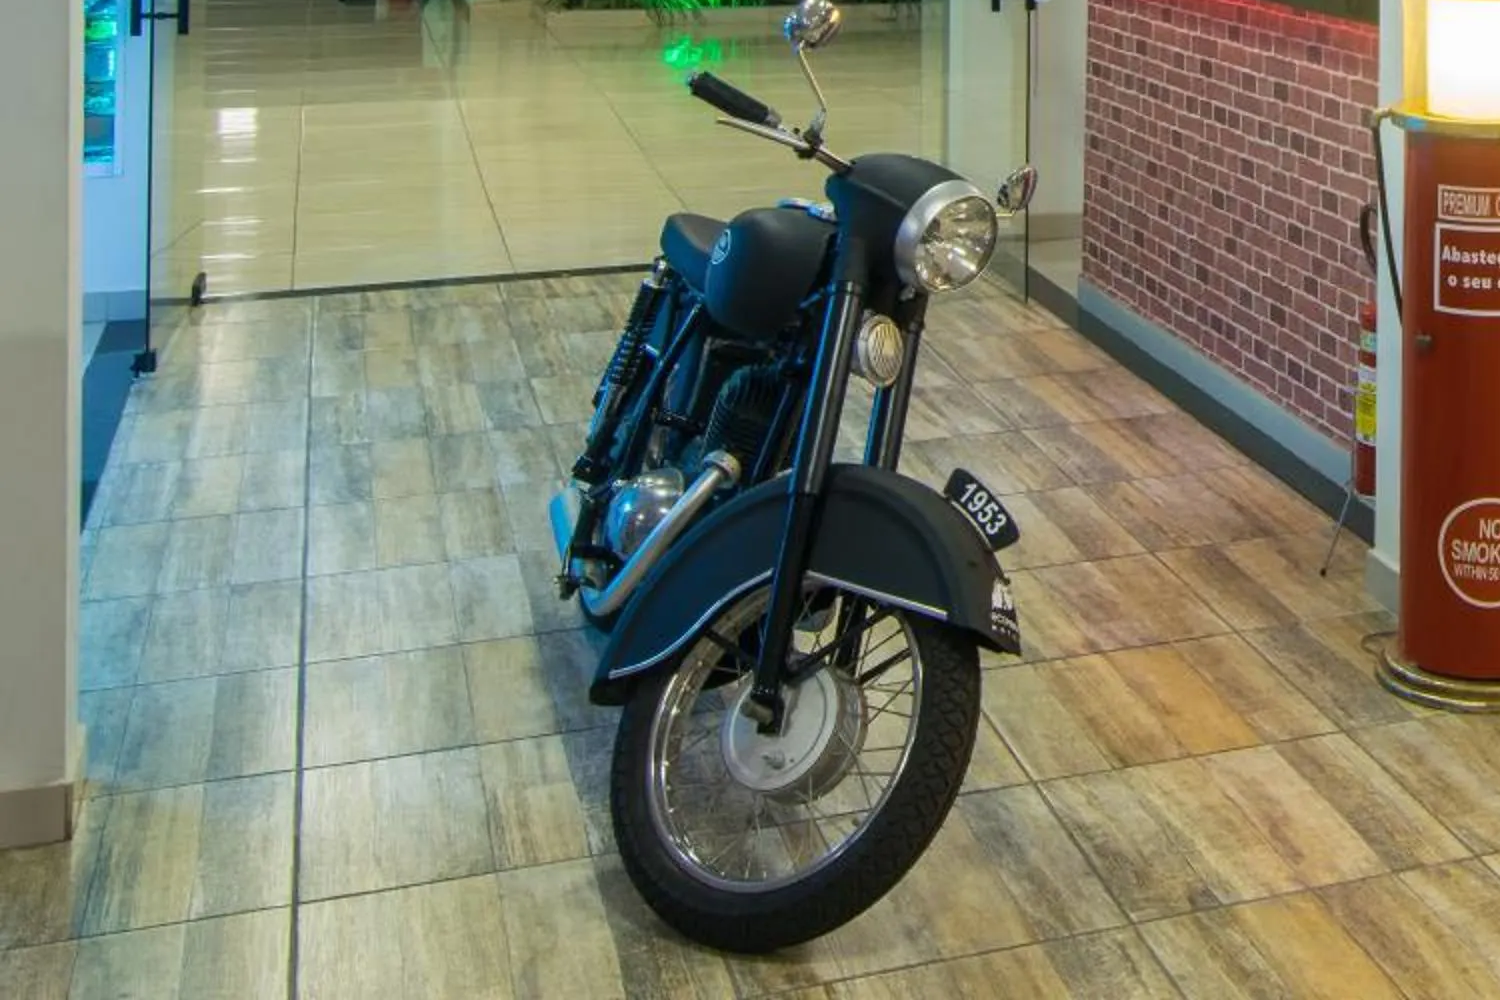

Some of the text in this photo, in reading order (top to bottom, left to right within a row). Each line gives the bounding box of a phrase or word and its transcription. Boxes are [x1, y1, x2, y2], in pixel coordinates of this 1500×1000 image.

[1443, 191, 1490, 216] PREMIUM
[1447, 274, 1458, 288] o
[1463, 276, 1492, 289] seu
[960, 483, 1006, 535] 1953
[1454, 563, 1486, 580] WITHIN
